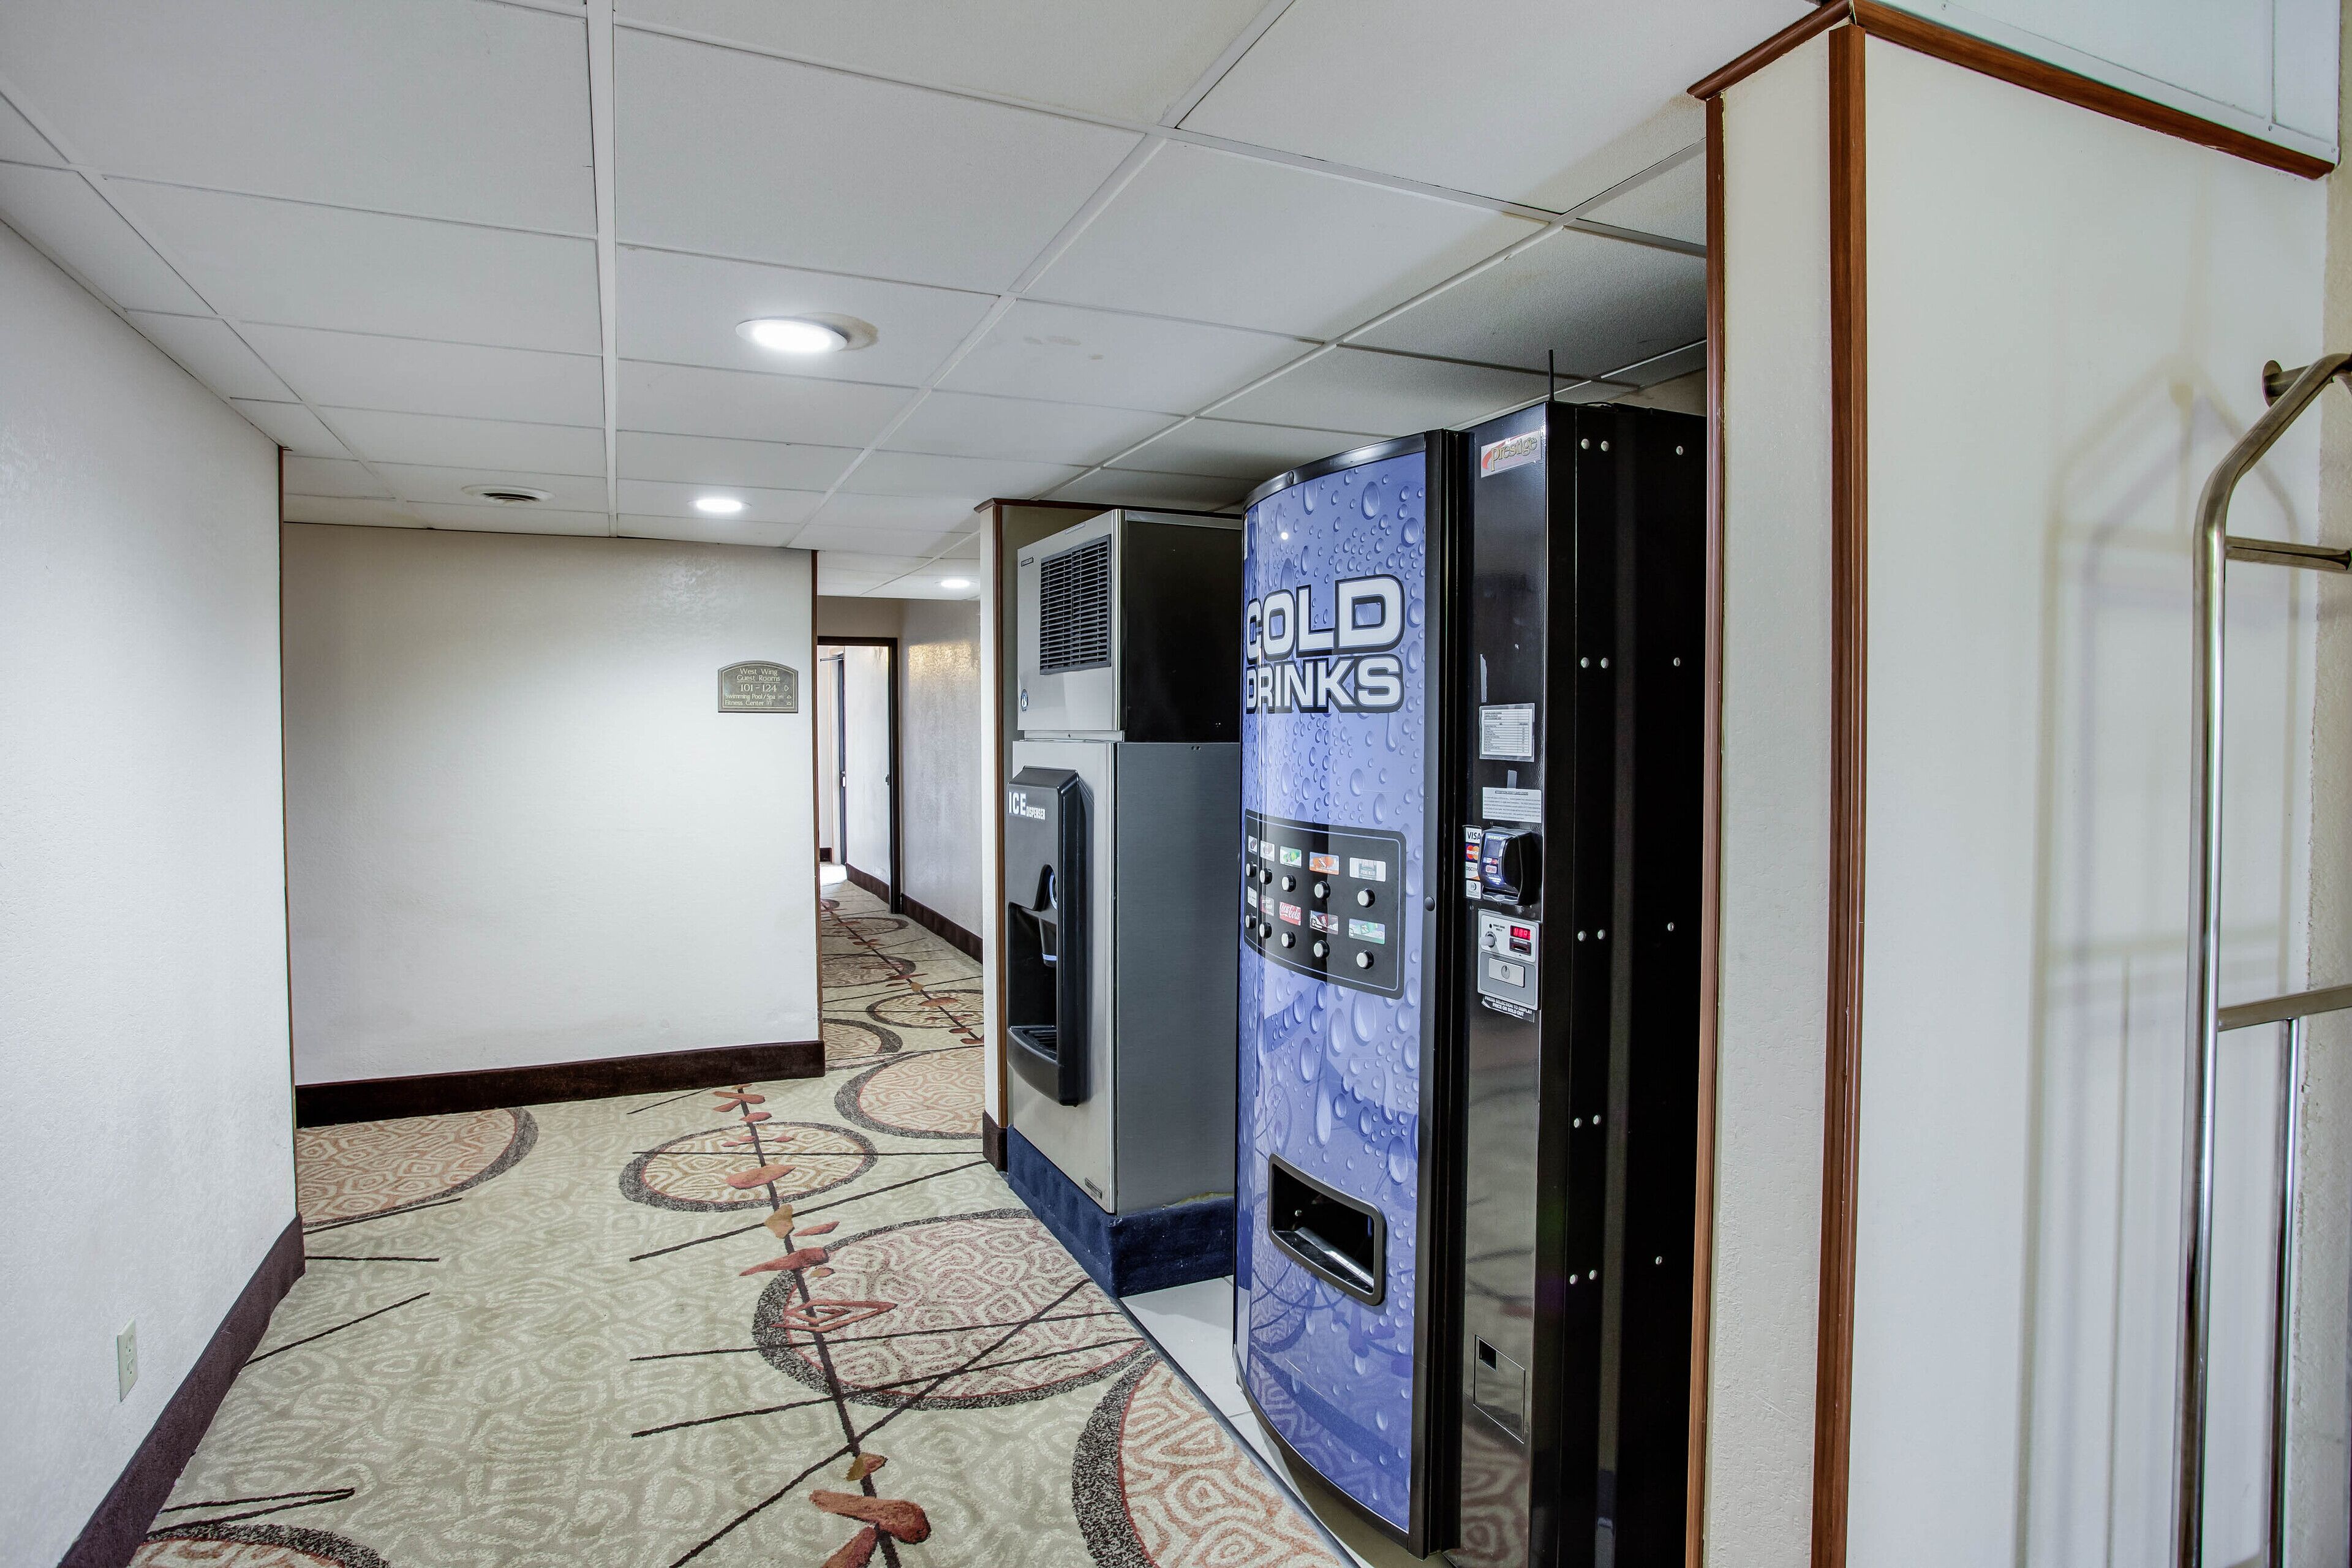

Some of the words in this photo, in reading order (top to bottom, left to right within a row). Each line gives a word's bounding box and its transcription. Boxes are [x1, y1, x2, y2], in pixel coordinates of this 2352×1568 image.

[1491, 435, 1538, 472] prestige
[1246, 573, 1405, 665] COLD
[1246, 654, 1405, 714] DRINKS
[1009, 791, 1027, 816] ICE
[1026, 805, 1046, 820] DISPENSER
[1467, 831, 1481, 840] VISA
[1496, 999, 1513, 1008] SELECTION
